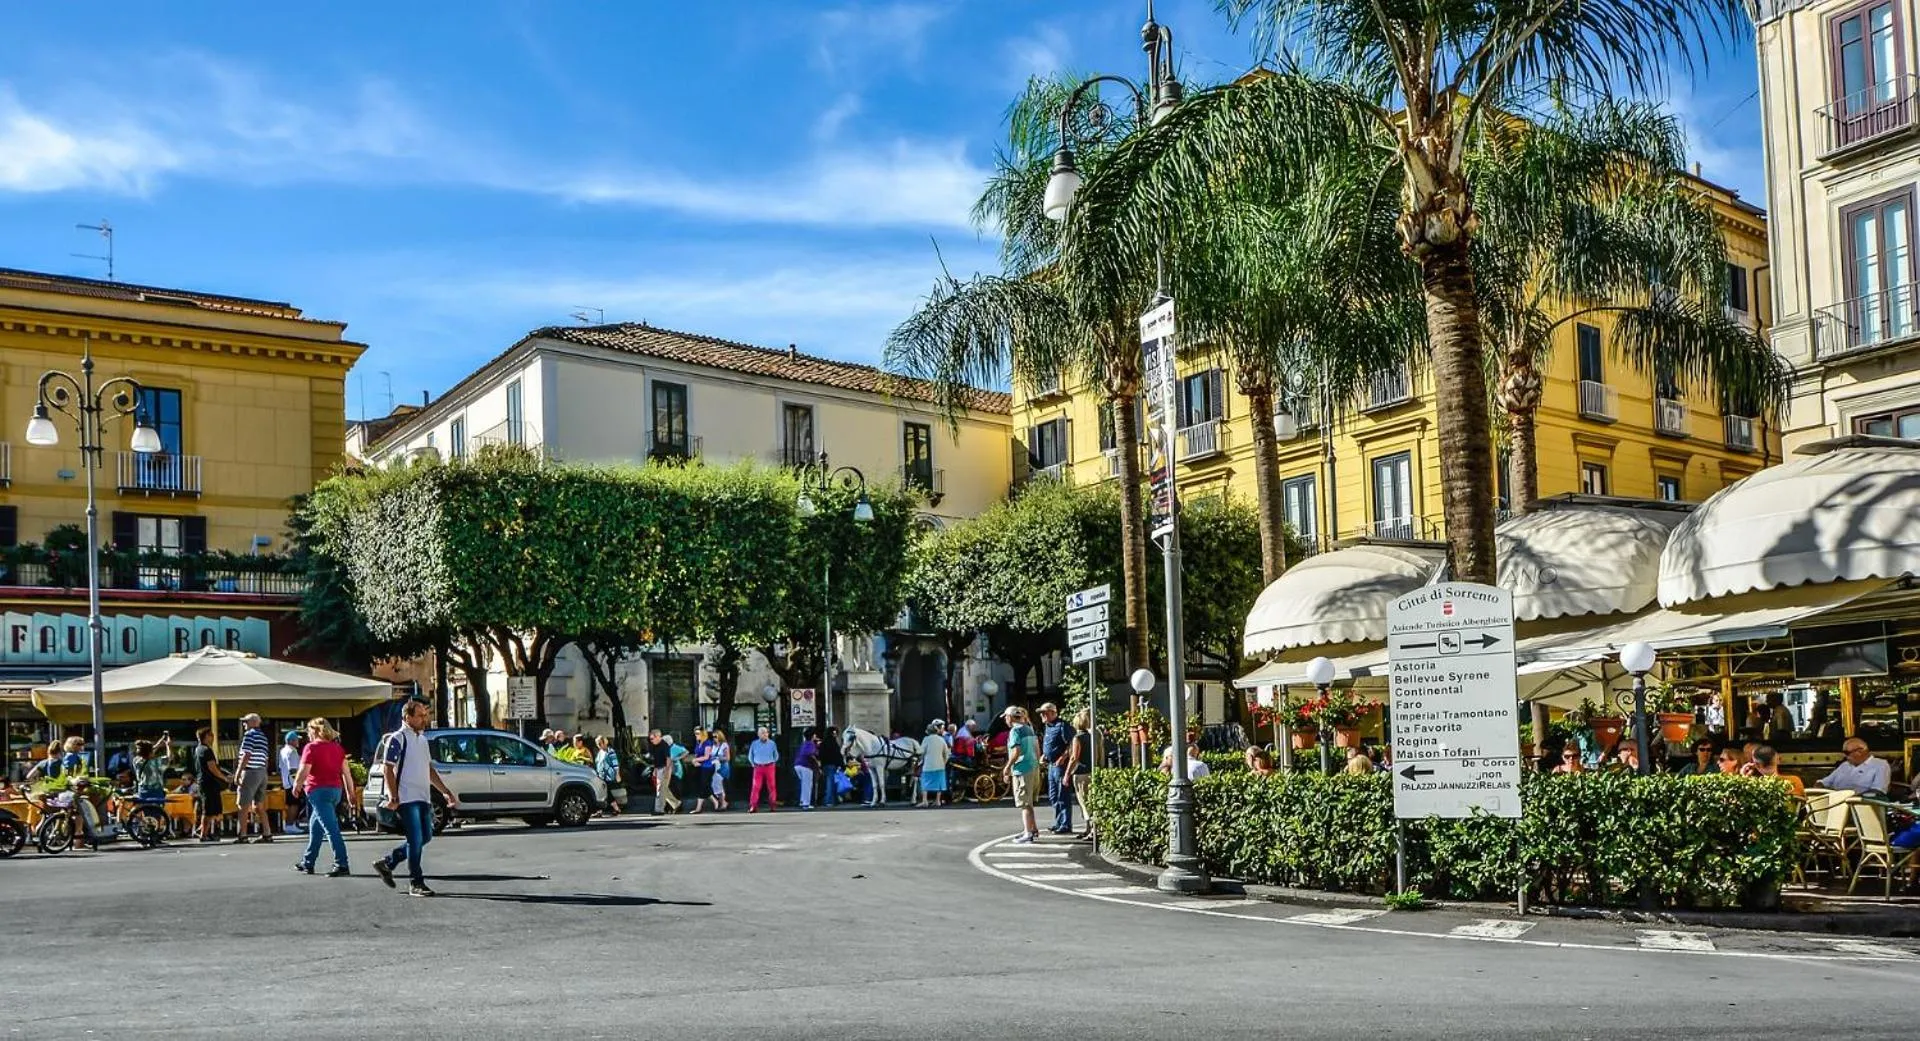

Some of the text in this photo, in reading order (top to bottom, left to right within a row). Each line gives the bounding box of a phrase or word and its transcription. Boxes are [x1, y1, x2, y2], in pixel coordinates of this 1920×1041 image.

[1430, 588, 1442, 600] di
[1446, 587, 1499, 604] Sorrento
[12, 624, 241, 654] FAUNO BAR
[1394, 661, 1436, 672] Astoria
[1395, 671, 1490, 684] Bellevue Syrene
[1395, 685, 1463, 697] Continental
[1396, 700, 1422, 709] Faro
[1396, 709, 1508, 722] Imperial Tramontano
[1396, 723, 1462, 734] La Favorita
[1397, 736, 1437, 748] Regina
[1397, 747, 1481, 759] Maison Tofani
[1462, 758, 1515, 767] De Corso
[1401, 783, 1437, 791] PALAZZO
